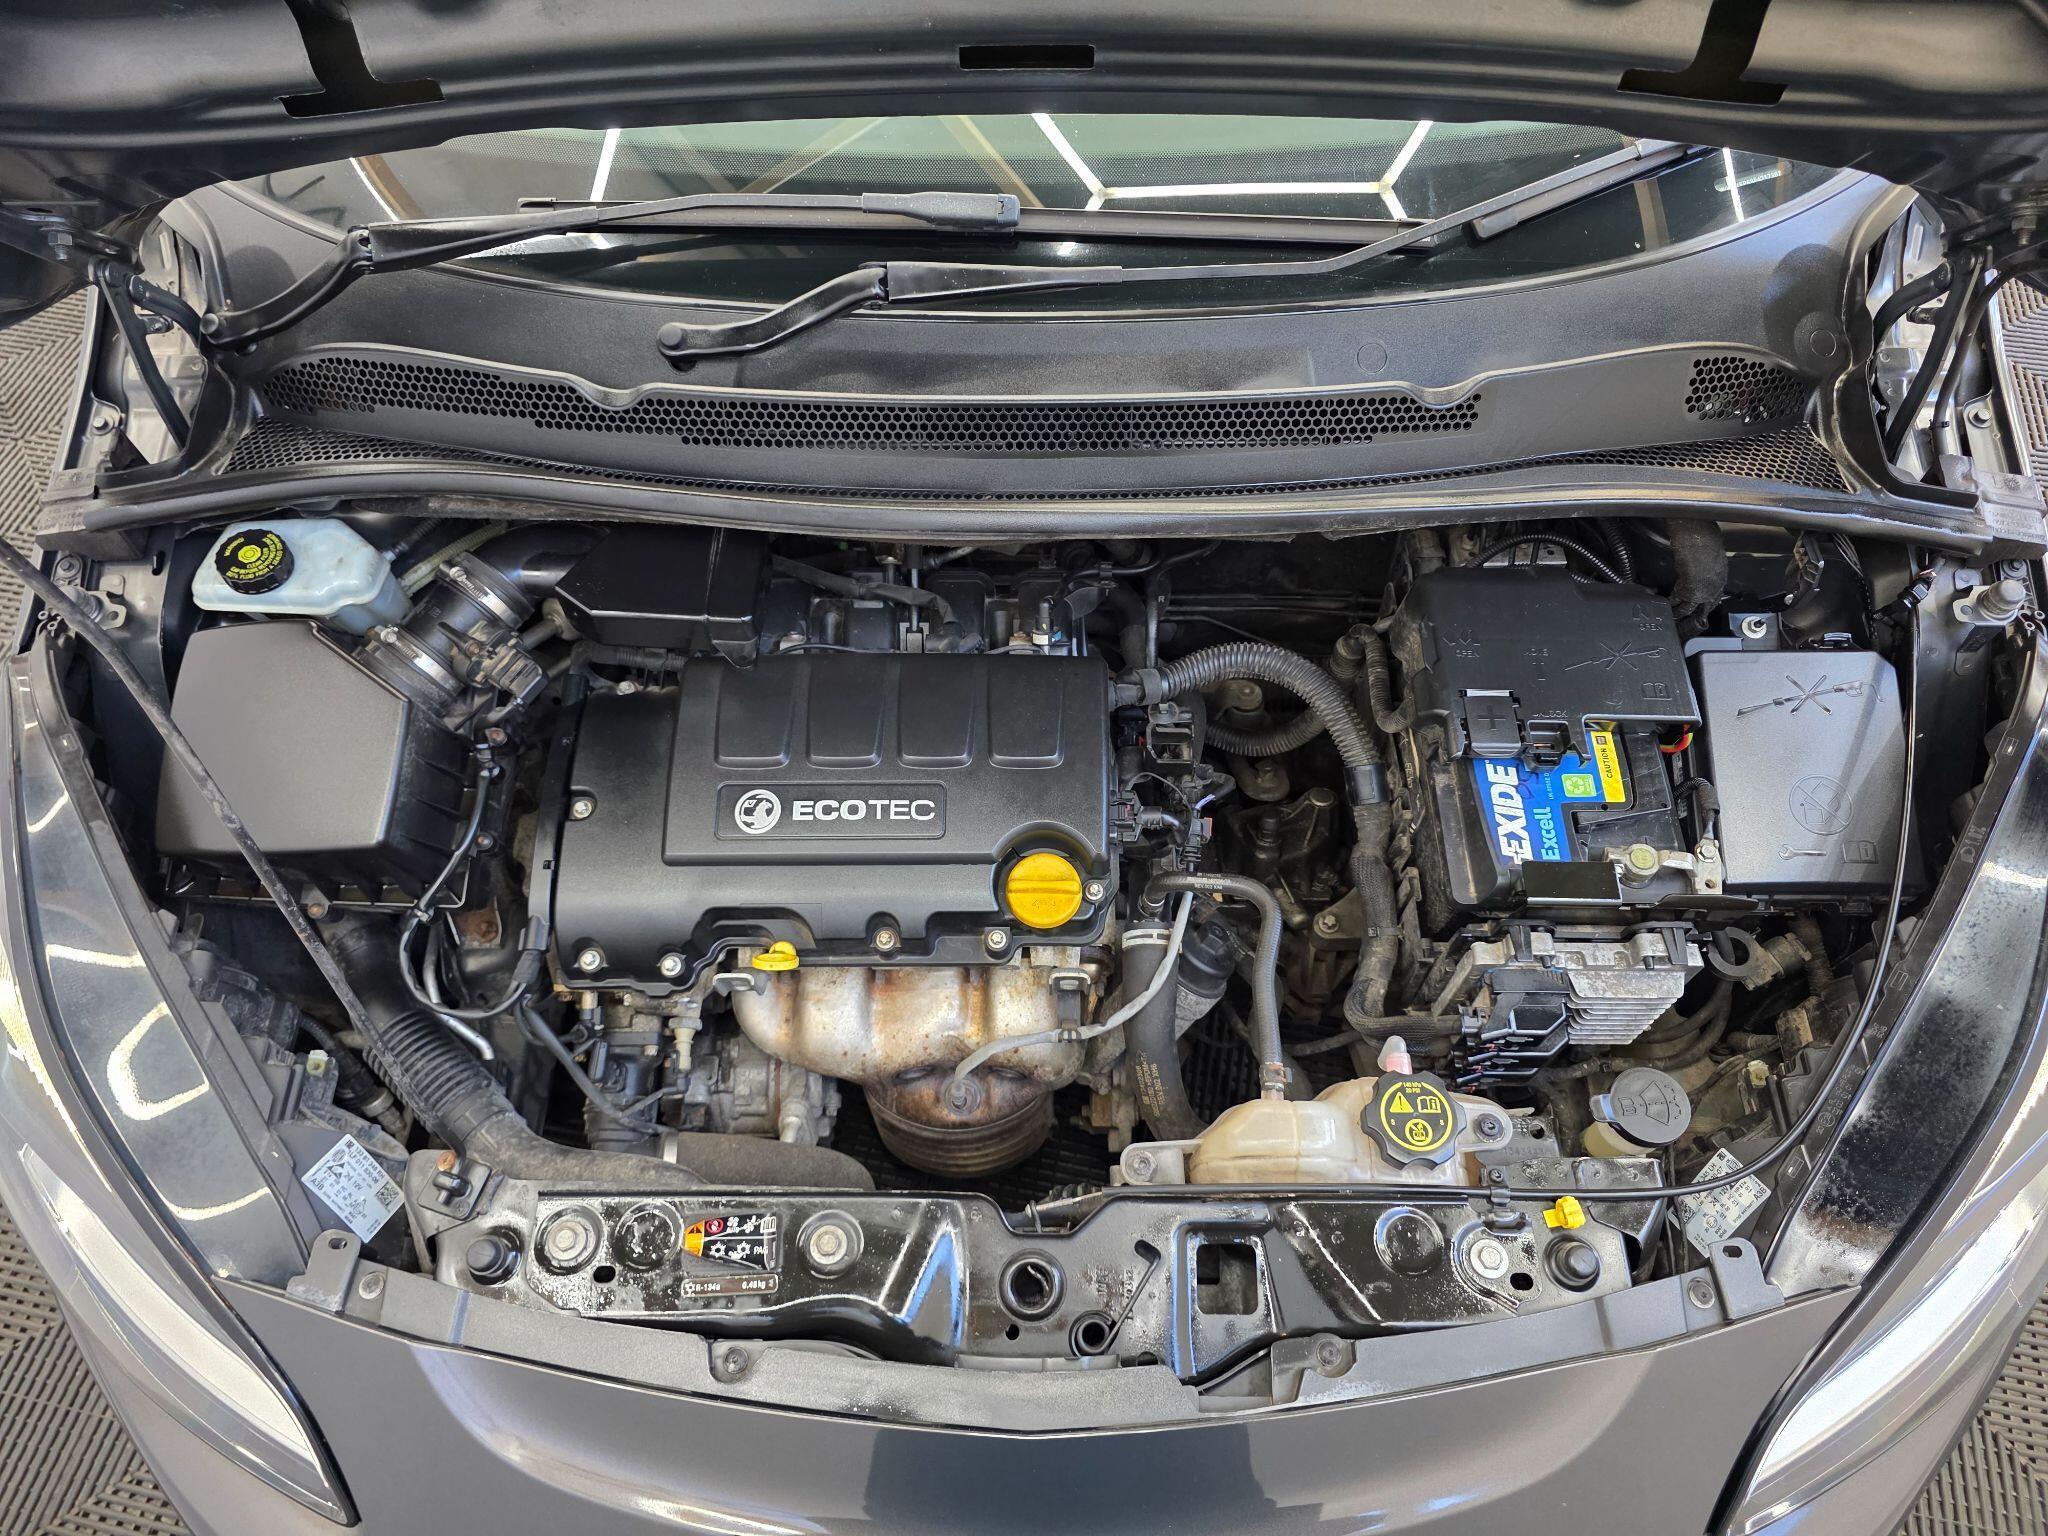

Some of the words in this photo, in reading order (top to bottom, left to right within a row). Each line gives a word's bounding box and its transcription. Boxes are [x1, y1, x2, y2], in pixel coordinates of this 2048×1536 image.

[1601, 746, 1613, 778] CAUTION
[792, 799, 936, 821] ECOTEC
[1487, 763, 1534, 864] EXIDE
[1534, 806, 1561, 861] Excell
[1707, 1162, 1716, 1172] LH
[1753, 1186, 1767, 1201] A3B
[753, 1246, 768, 1255] PAG
